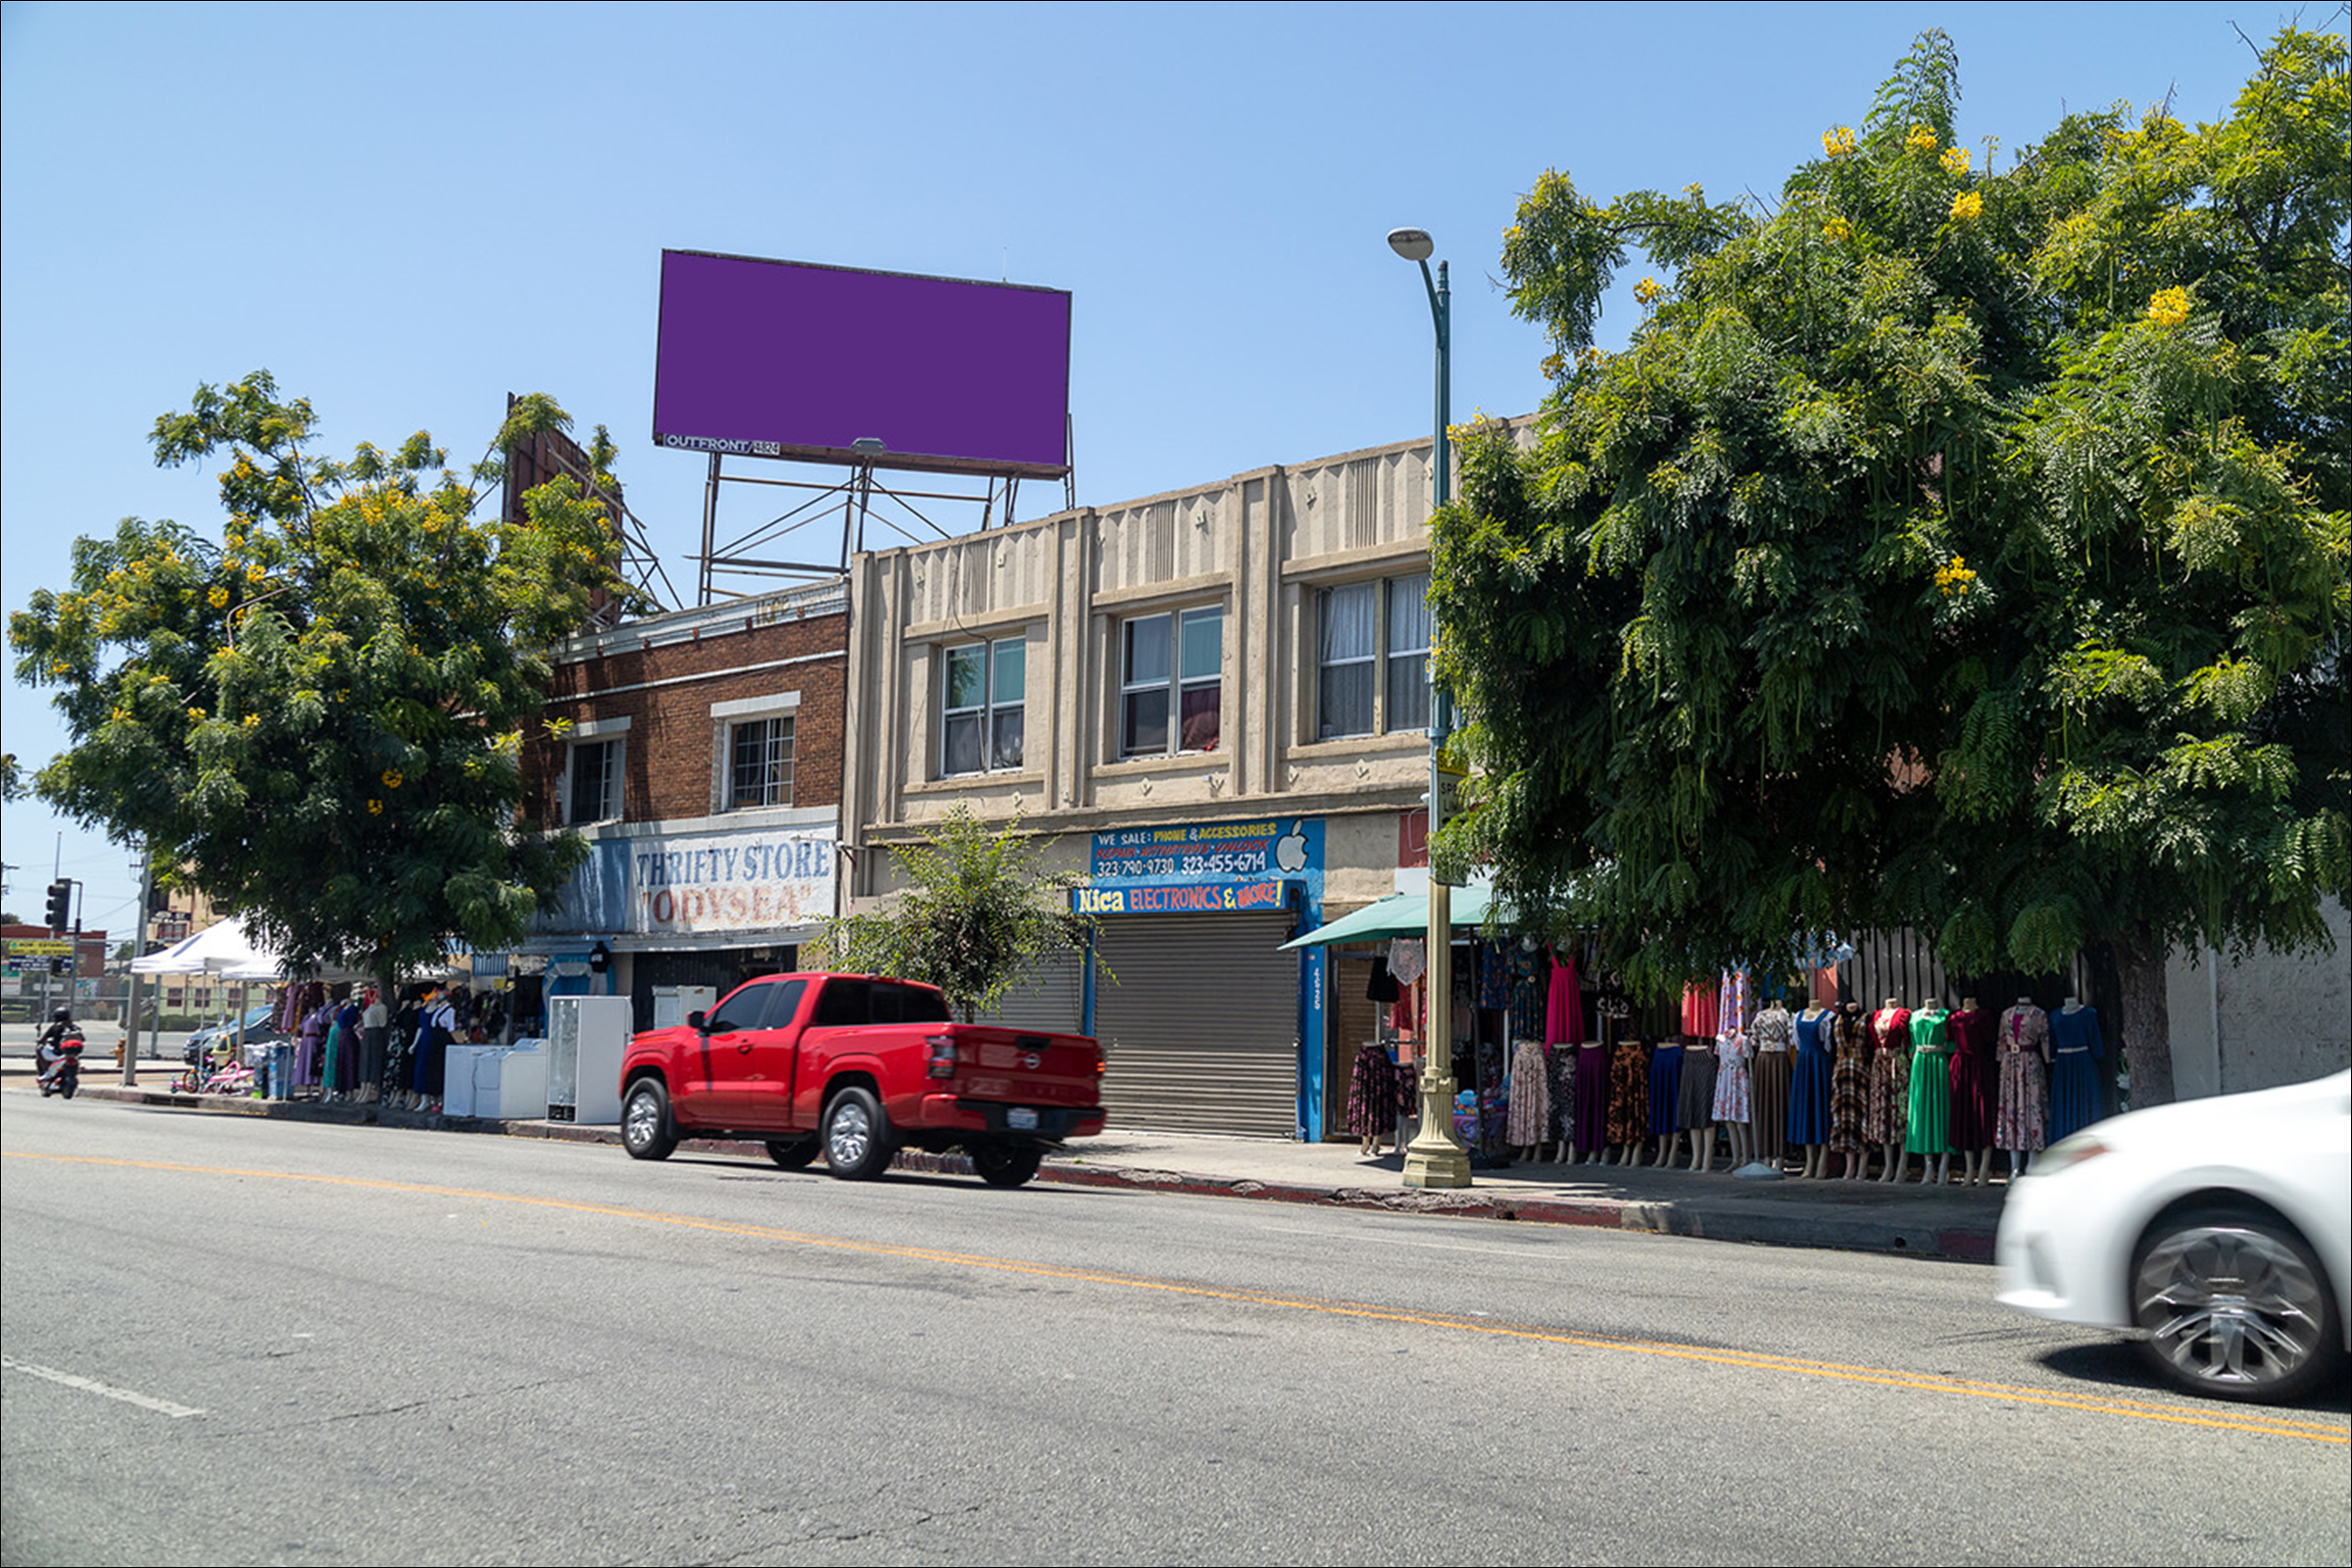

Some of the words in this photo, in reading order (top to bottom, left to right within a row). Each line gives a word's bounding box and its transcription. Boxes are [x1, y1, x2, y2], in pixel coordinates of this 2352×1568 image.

[1099, 833, 1116, 846] WE
[1153, 828, 1187, 843] PHONE
[1189, 827, 1198, 842] &
[1199, 822, 1276, 840] ACCESSORIES
[637, 848, 738, 886] THRIFTY
[743, 840, 830, 881] STORE
[1078, 888, 1125, 912] Nica
[1129, 885, 1223, 910] ELECTRONICS
[1223, 886, 1237, 909] &
